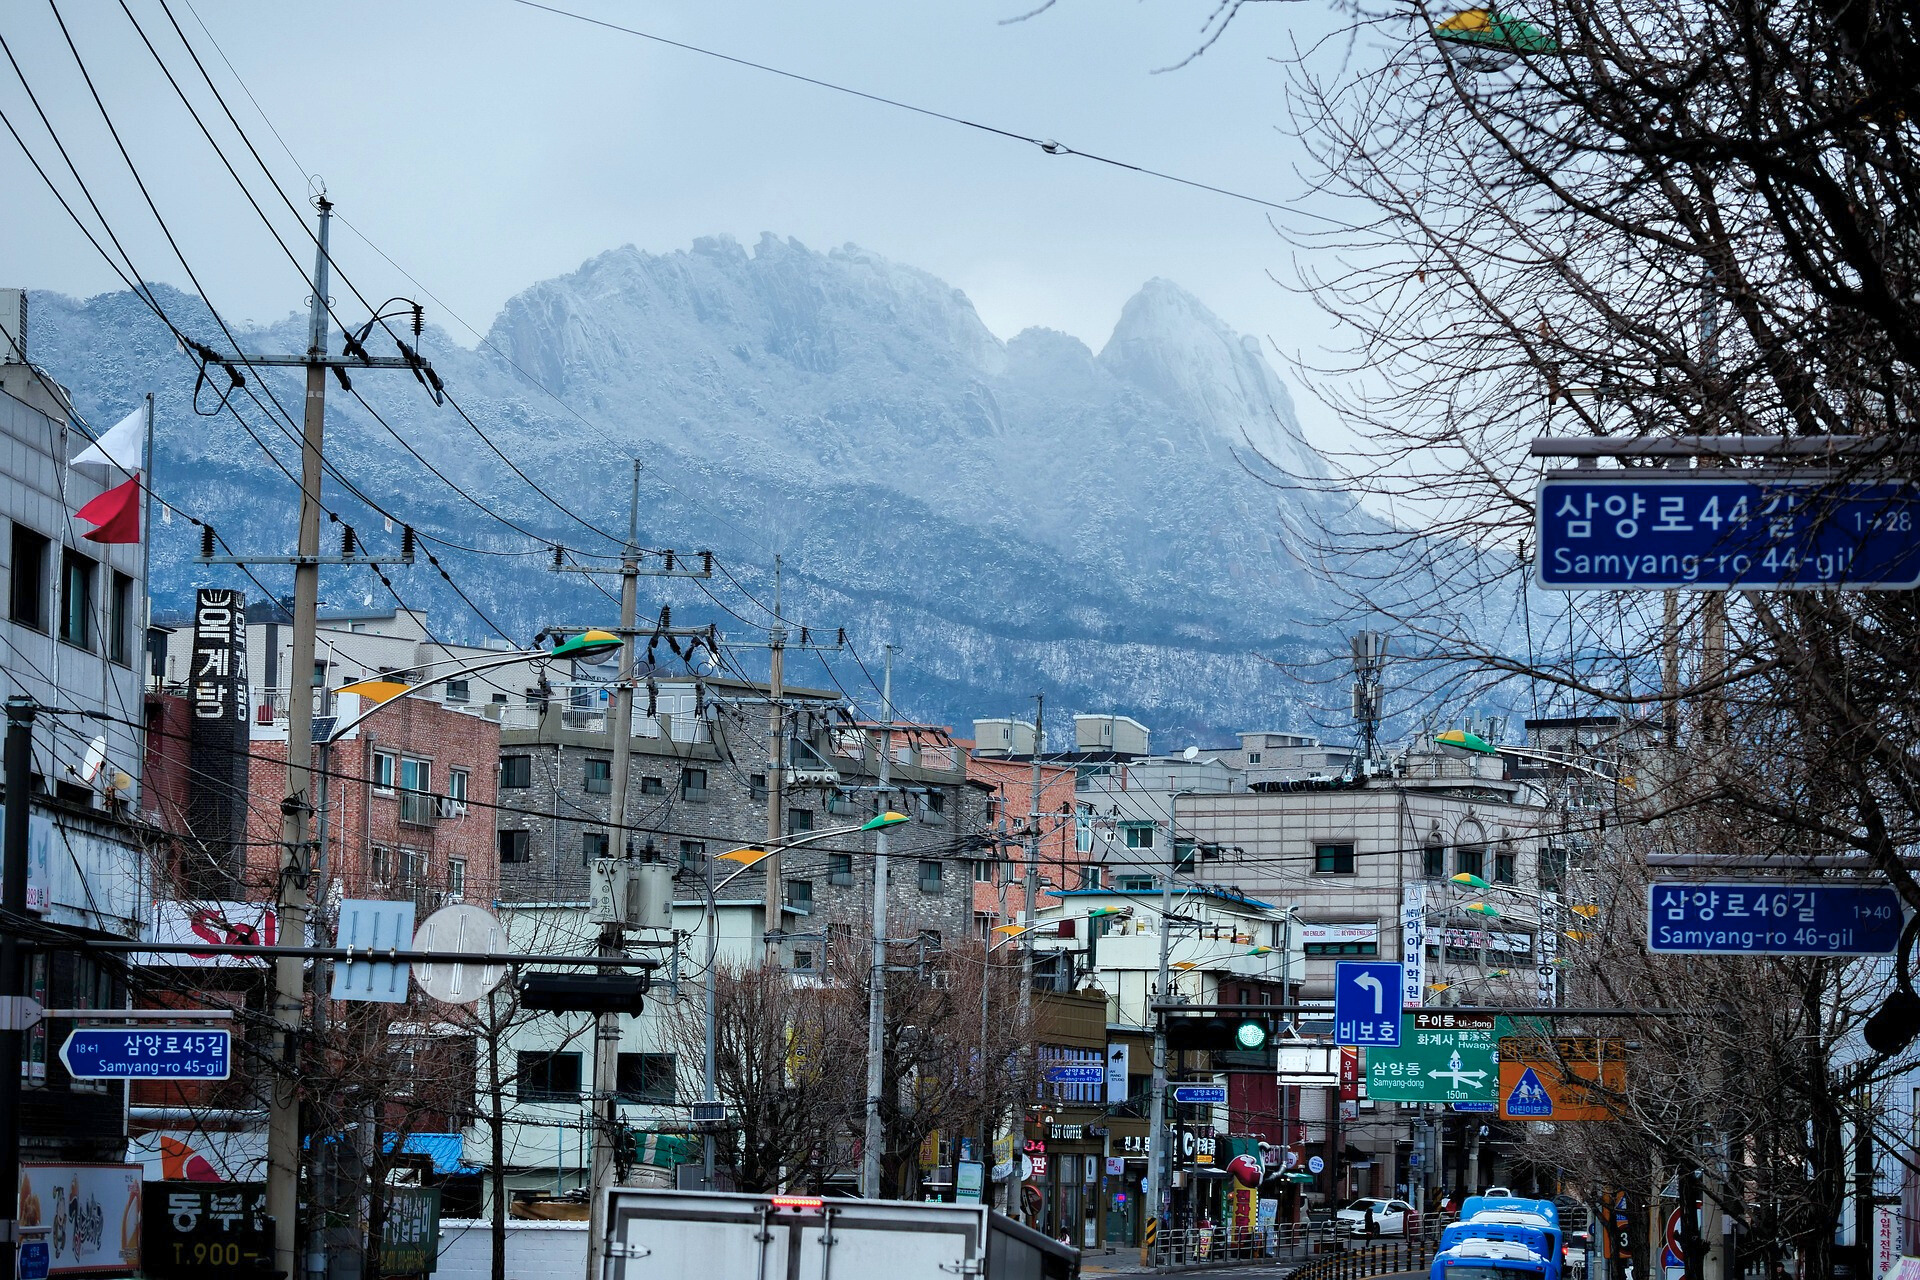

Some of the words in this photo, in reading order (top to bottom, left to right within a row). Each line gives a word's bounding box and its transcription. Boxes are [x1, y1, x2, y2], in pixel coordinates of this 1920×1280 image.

[1555, 547, 1752, 579] Samyang-ro
[1762, 547, 1854, 579] 44-gil
[1661, 891, 1816, 922] 삼양로46길
[1659, 926, 1787, 949] Samyang-ro
[1793, 928, 1853, 949] 46-gil
[1406, 921, 1420, 999] 아이비학원
[1417, 1014, 1455, 1027] 우이동
[1340, 1020, 1396, 1042] 비보호
[124, 1035, 223, 1057] 삼양로45길
[1417, 1034, 1454, 1046] 화계사
[99, 1060, 180, 1074] Samyang-ro
[184, 1060, 223, 1075] 45-gil
[1064, 1068, 1101, 1077] 삼양로47길
[1372, 1062, 1421, 1076] 삼양동
[1373, 1078, 1425, 1089] Samyang-dong
[1446, 1091, 1468, 1100] 150m
[1509, 1105, 1549, 1114] 어린이보호
[1880, 1208, 1891, 1272] 수입차전차종
